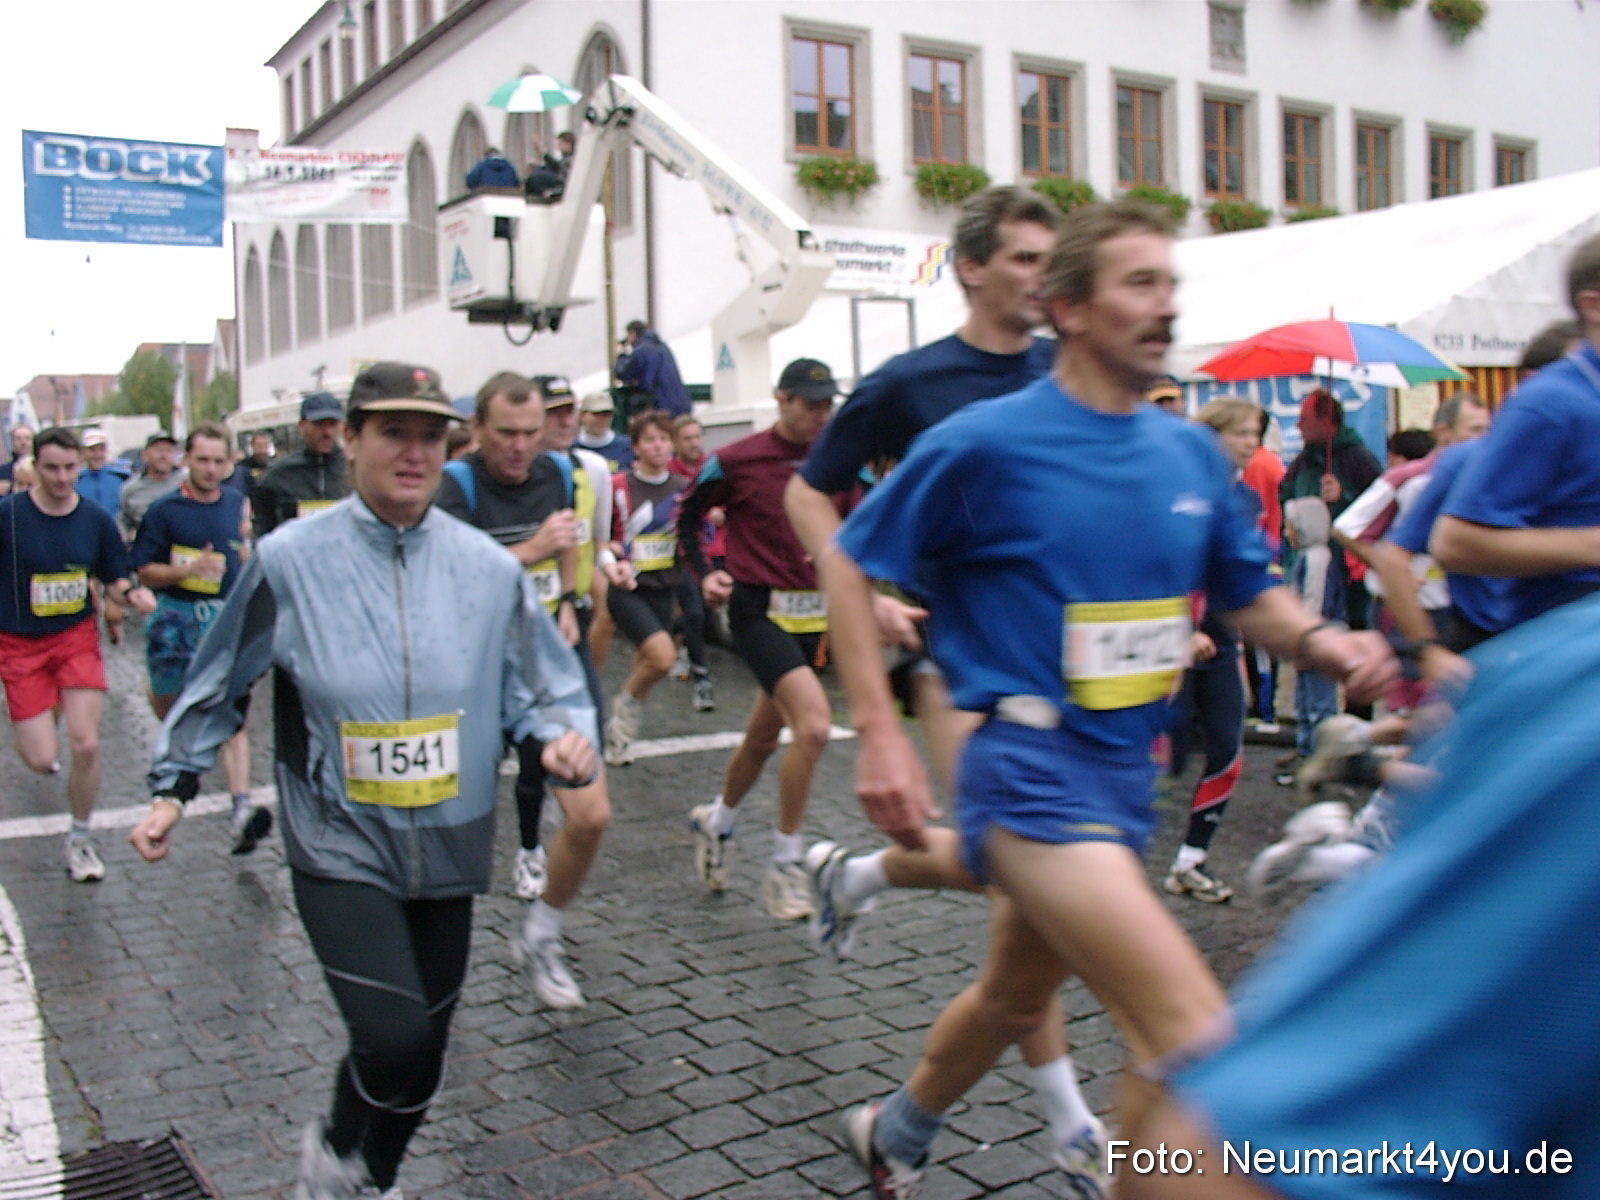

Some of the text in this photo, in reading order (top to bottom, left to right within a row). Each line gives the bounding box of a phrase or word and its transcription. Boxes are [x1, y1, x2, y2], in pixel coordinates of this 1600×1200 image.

[34, 137, 213, 187] BOCK
[825, 240, 907, 257] stadtwerke
[834, 259, 893, 273] umarkt
[369, 734, 445, 775] 1541
